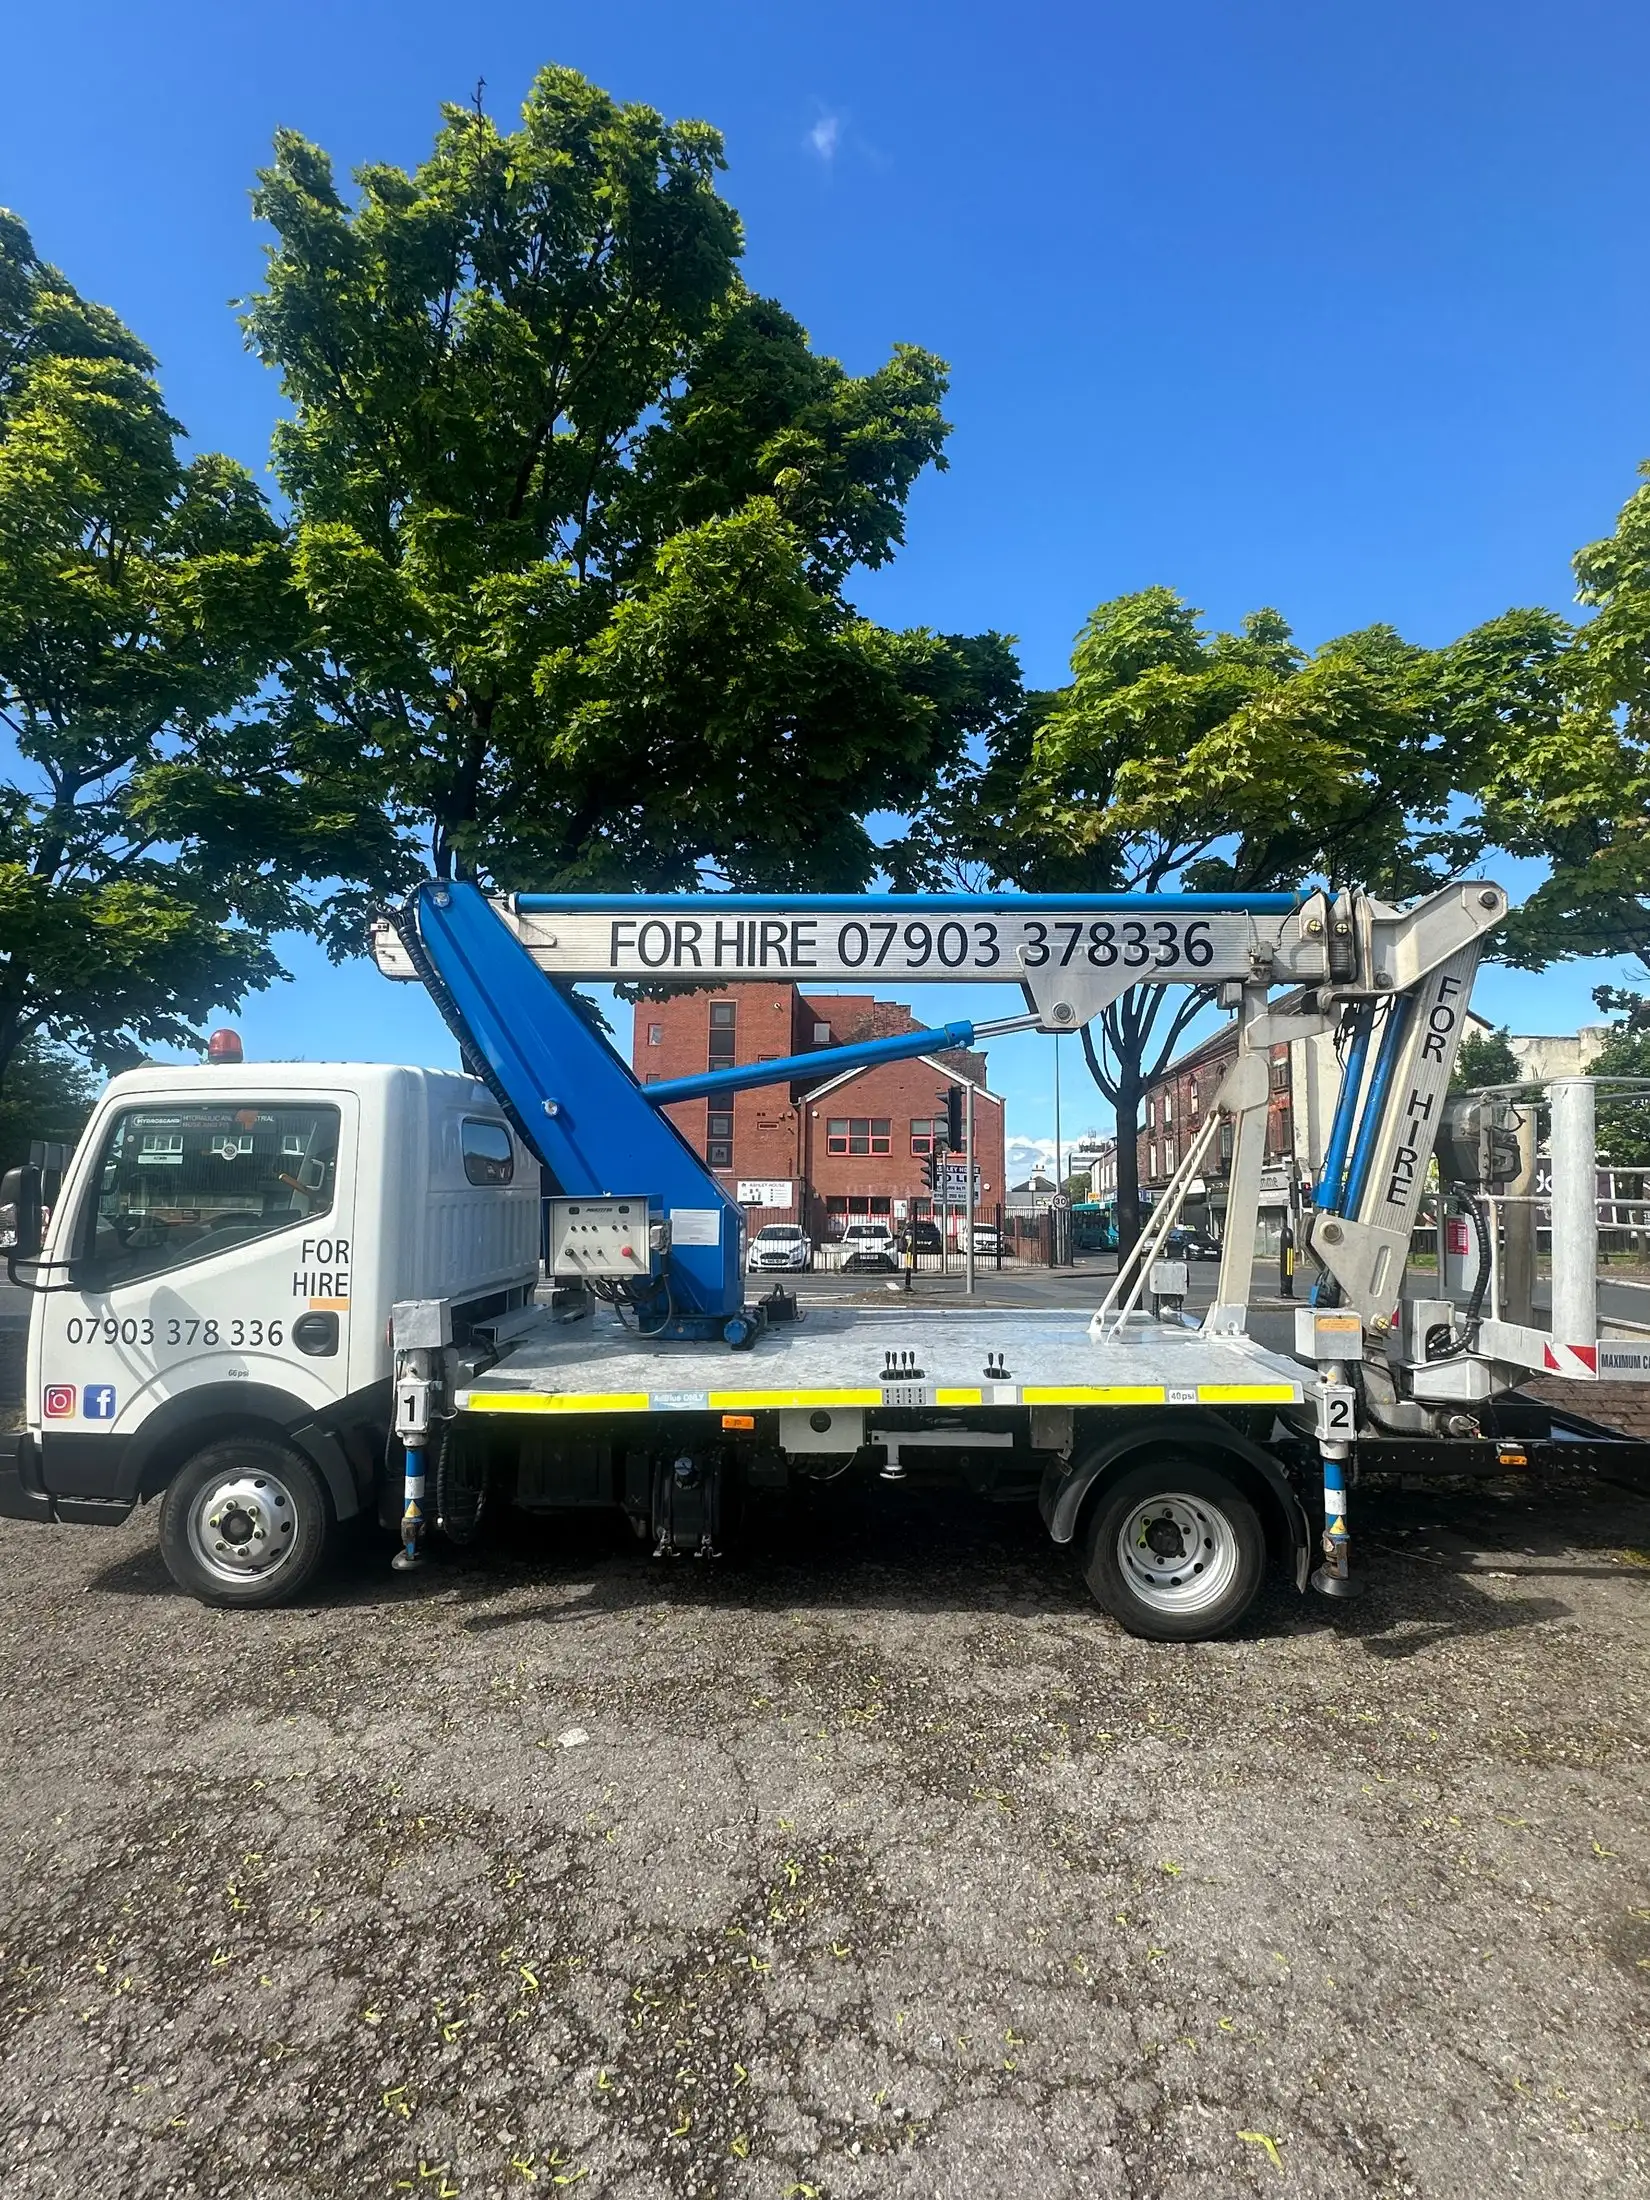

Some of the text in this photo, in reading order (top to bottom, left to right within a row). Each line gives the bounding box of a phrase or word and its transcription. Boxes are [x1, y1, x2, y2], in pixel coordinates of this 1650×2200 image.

[610, 920, 1214, 967] FOR HIRE 07903 378336
[1386, 975, 1461, 1207] FOR HIRE
[1054, 1198, 1066, 1206] 30
[301, 1239, 350, 1264] FOR
[292, 1272, 349, 1297] HIRE
[66, 1317, 284, 1347] 07903 378 336
[1601, 1353, 1641, 1369] MAXIMUM
[403, 1394, 416, 1422] 1
[1329, 1399, 1349, 1428] 2
